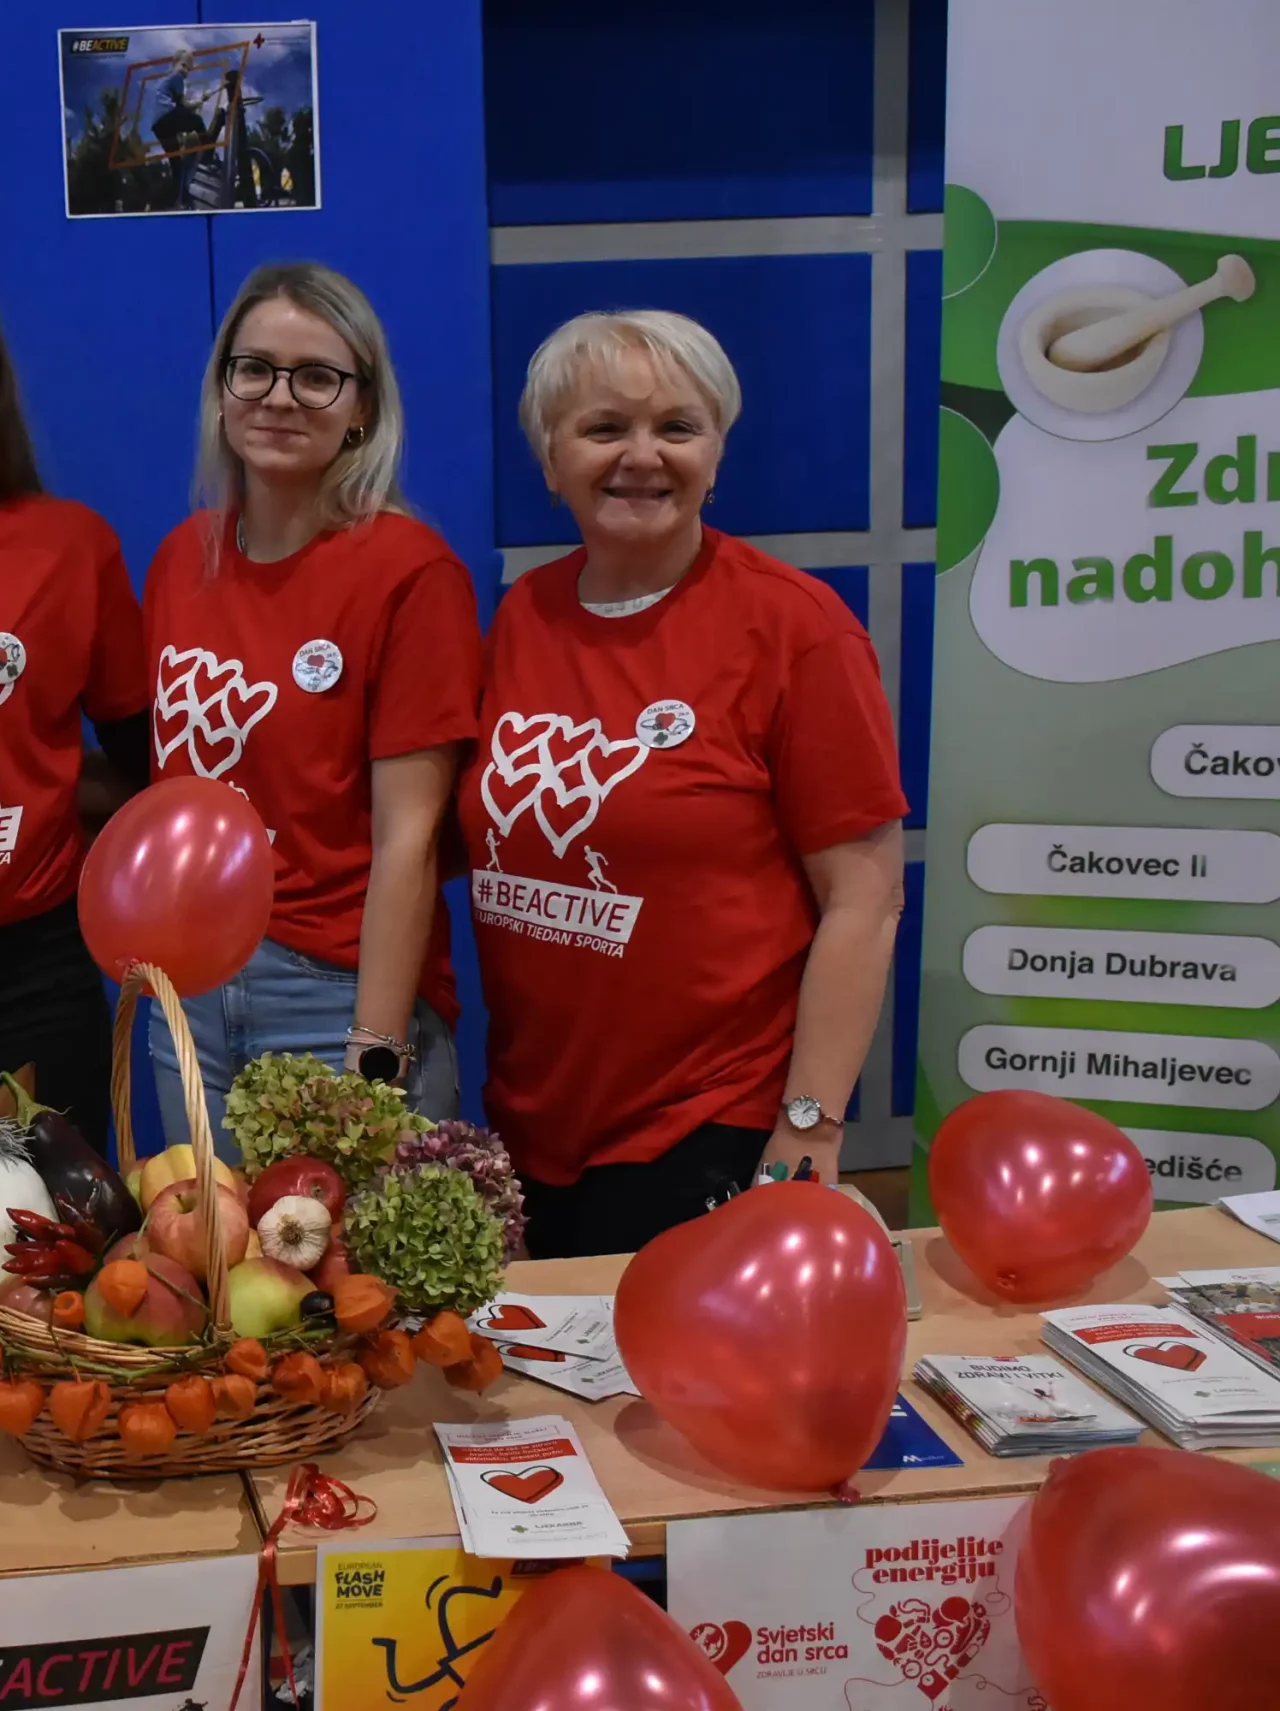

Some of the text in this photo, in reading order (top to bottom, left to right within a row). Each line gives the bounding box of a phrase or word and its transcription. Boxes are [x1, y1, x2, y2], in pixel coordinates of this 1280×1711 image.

[72, 39, 127, 52] #BEACTIVE
[1163, 115, 1280, 181] LJE
[1009, 530, 1280, 608] nadoh
[647, 703, 684, 715] DAN SRCA
[1184, 742, 1280, 778] Čako
[1046, 843, 1180, 877] Čakovec
[477, 878, 630, 933] #BEACTIVE
[474, 910, 625, 959] EUROPSKI TJEDAN SPORTA
[1007, 948, 1237, 982] Donja Dubrava
[984, 1046, 1252, 1087] Gornji Mihaljevec
[1143, 1155, 1243, 1182] edišće
[955, 1371, 1013, 1379] ZDRAVI
[1021, 1371, 1065, 1379] VITKI
[968, 1364, 1032, 1372] BUDIMO
[337, 1562, 383, 1570] EUROPEAN
[865, 1536, 1004, 1569] podijelite
[335, 1570, 385, 1585] FLASH
[872, 1559, 996, 1586] energiju
[336, 1584, 384, 1598] MOVE
[756, 1621, 835, 1648] Svjetski
[756, 1644, 849, 1664] dan srca
[756, 1669, 795, 1680] ZDRAVLJE
